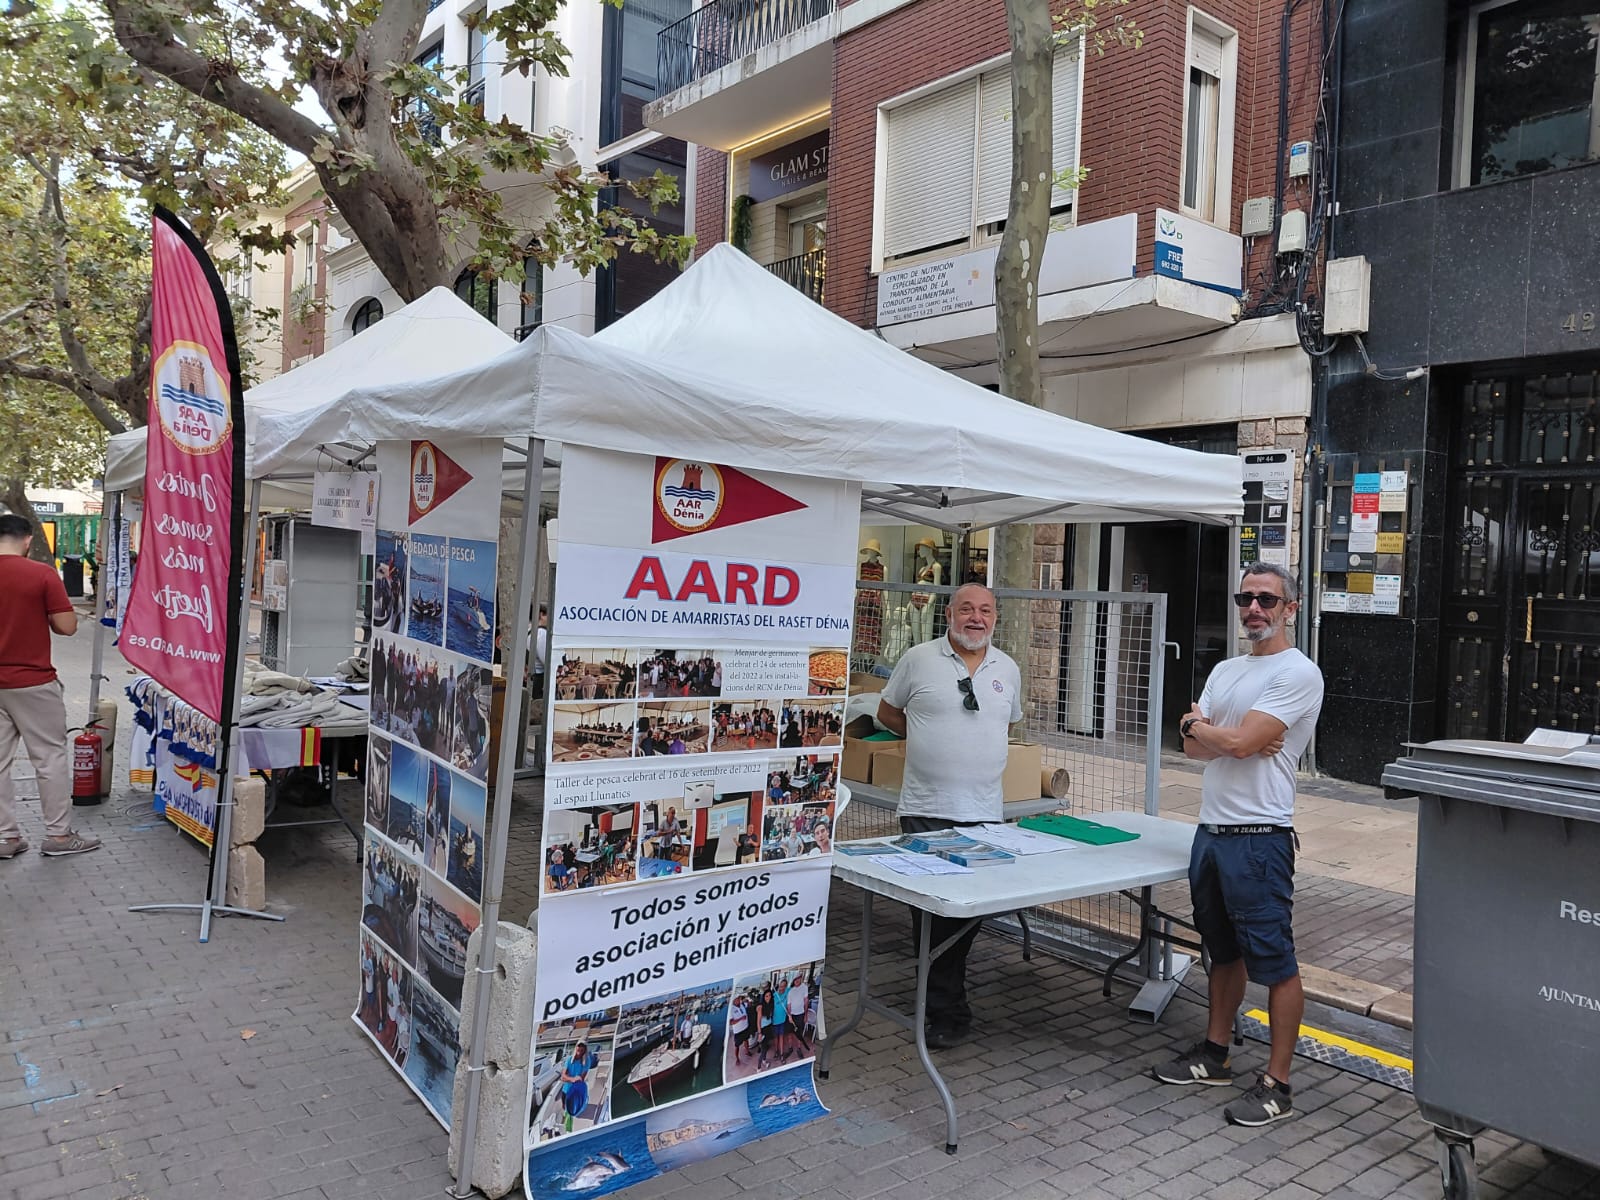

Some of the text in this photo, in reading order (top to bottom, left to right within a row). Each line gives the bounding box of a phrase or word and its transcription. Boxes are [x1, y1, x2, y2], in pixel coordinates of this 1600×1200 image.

[771, 146, 828, 181] GLAM ST
[809, 166, 828, 178] BEAU
[886, 261, 955, 284] CENTRO DE NUTRICIÓN
[892, 271, 947, 290] ESPECIALIZADO EN
[882, 287, 956, 308] CONDUCTA ALIMENTARIA
[890, 284, 928, 298] TRANSTORNO
[931, 282, 938, 290] DE
[941, 304, 952, 312] CITA
[954, 300, 974, 309] PREVIA
[1561, 311, 1595, 333] 42
[673, 508, 705, 520] Dénia
[676, 499, 702, 510] AAR
[402, 540, 439, 557] QUEDADA
[440, 545, 450, 559] DE
[451, 547, 476, 562] PESCA
[622, 555, 801, 607] AARD
[558, 605, 849, 630] ASOCIACIÓN DE AMARRISTAS DEL RASET DÉNIA
[734, 648, 800, 659] Menjar de germanor
[725, 660, 751, 668] celebrat
[752, 660, 759, 668] el
[769, 660, 777, 668] de
[779, 660, 806, 668] setembre
[729, 672, 741, 680] del
[742, 672, 758, 680] 2022
[764, 672, 773, 680] les
[725, 684, 744, 692] cions
[744, 683, 755, 691] del
[756, 683, 773, 691] RCN
[774, 683, 783, 691] de
[553, 763, 762, 789] Taller de pesca celebrat el 16 de setembre del 2022
[553, 788, 631, 806] al espai Llunatics
[1240, 826, 1273, 834] ZEALAND
[610, 872, 771, 930] Todos somos
[575, 891, 799, 974] asociación y todos
[542, 905, 824, 1021] podemos benificiarnos!
